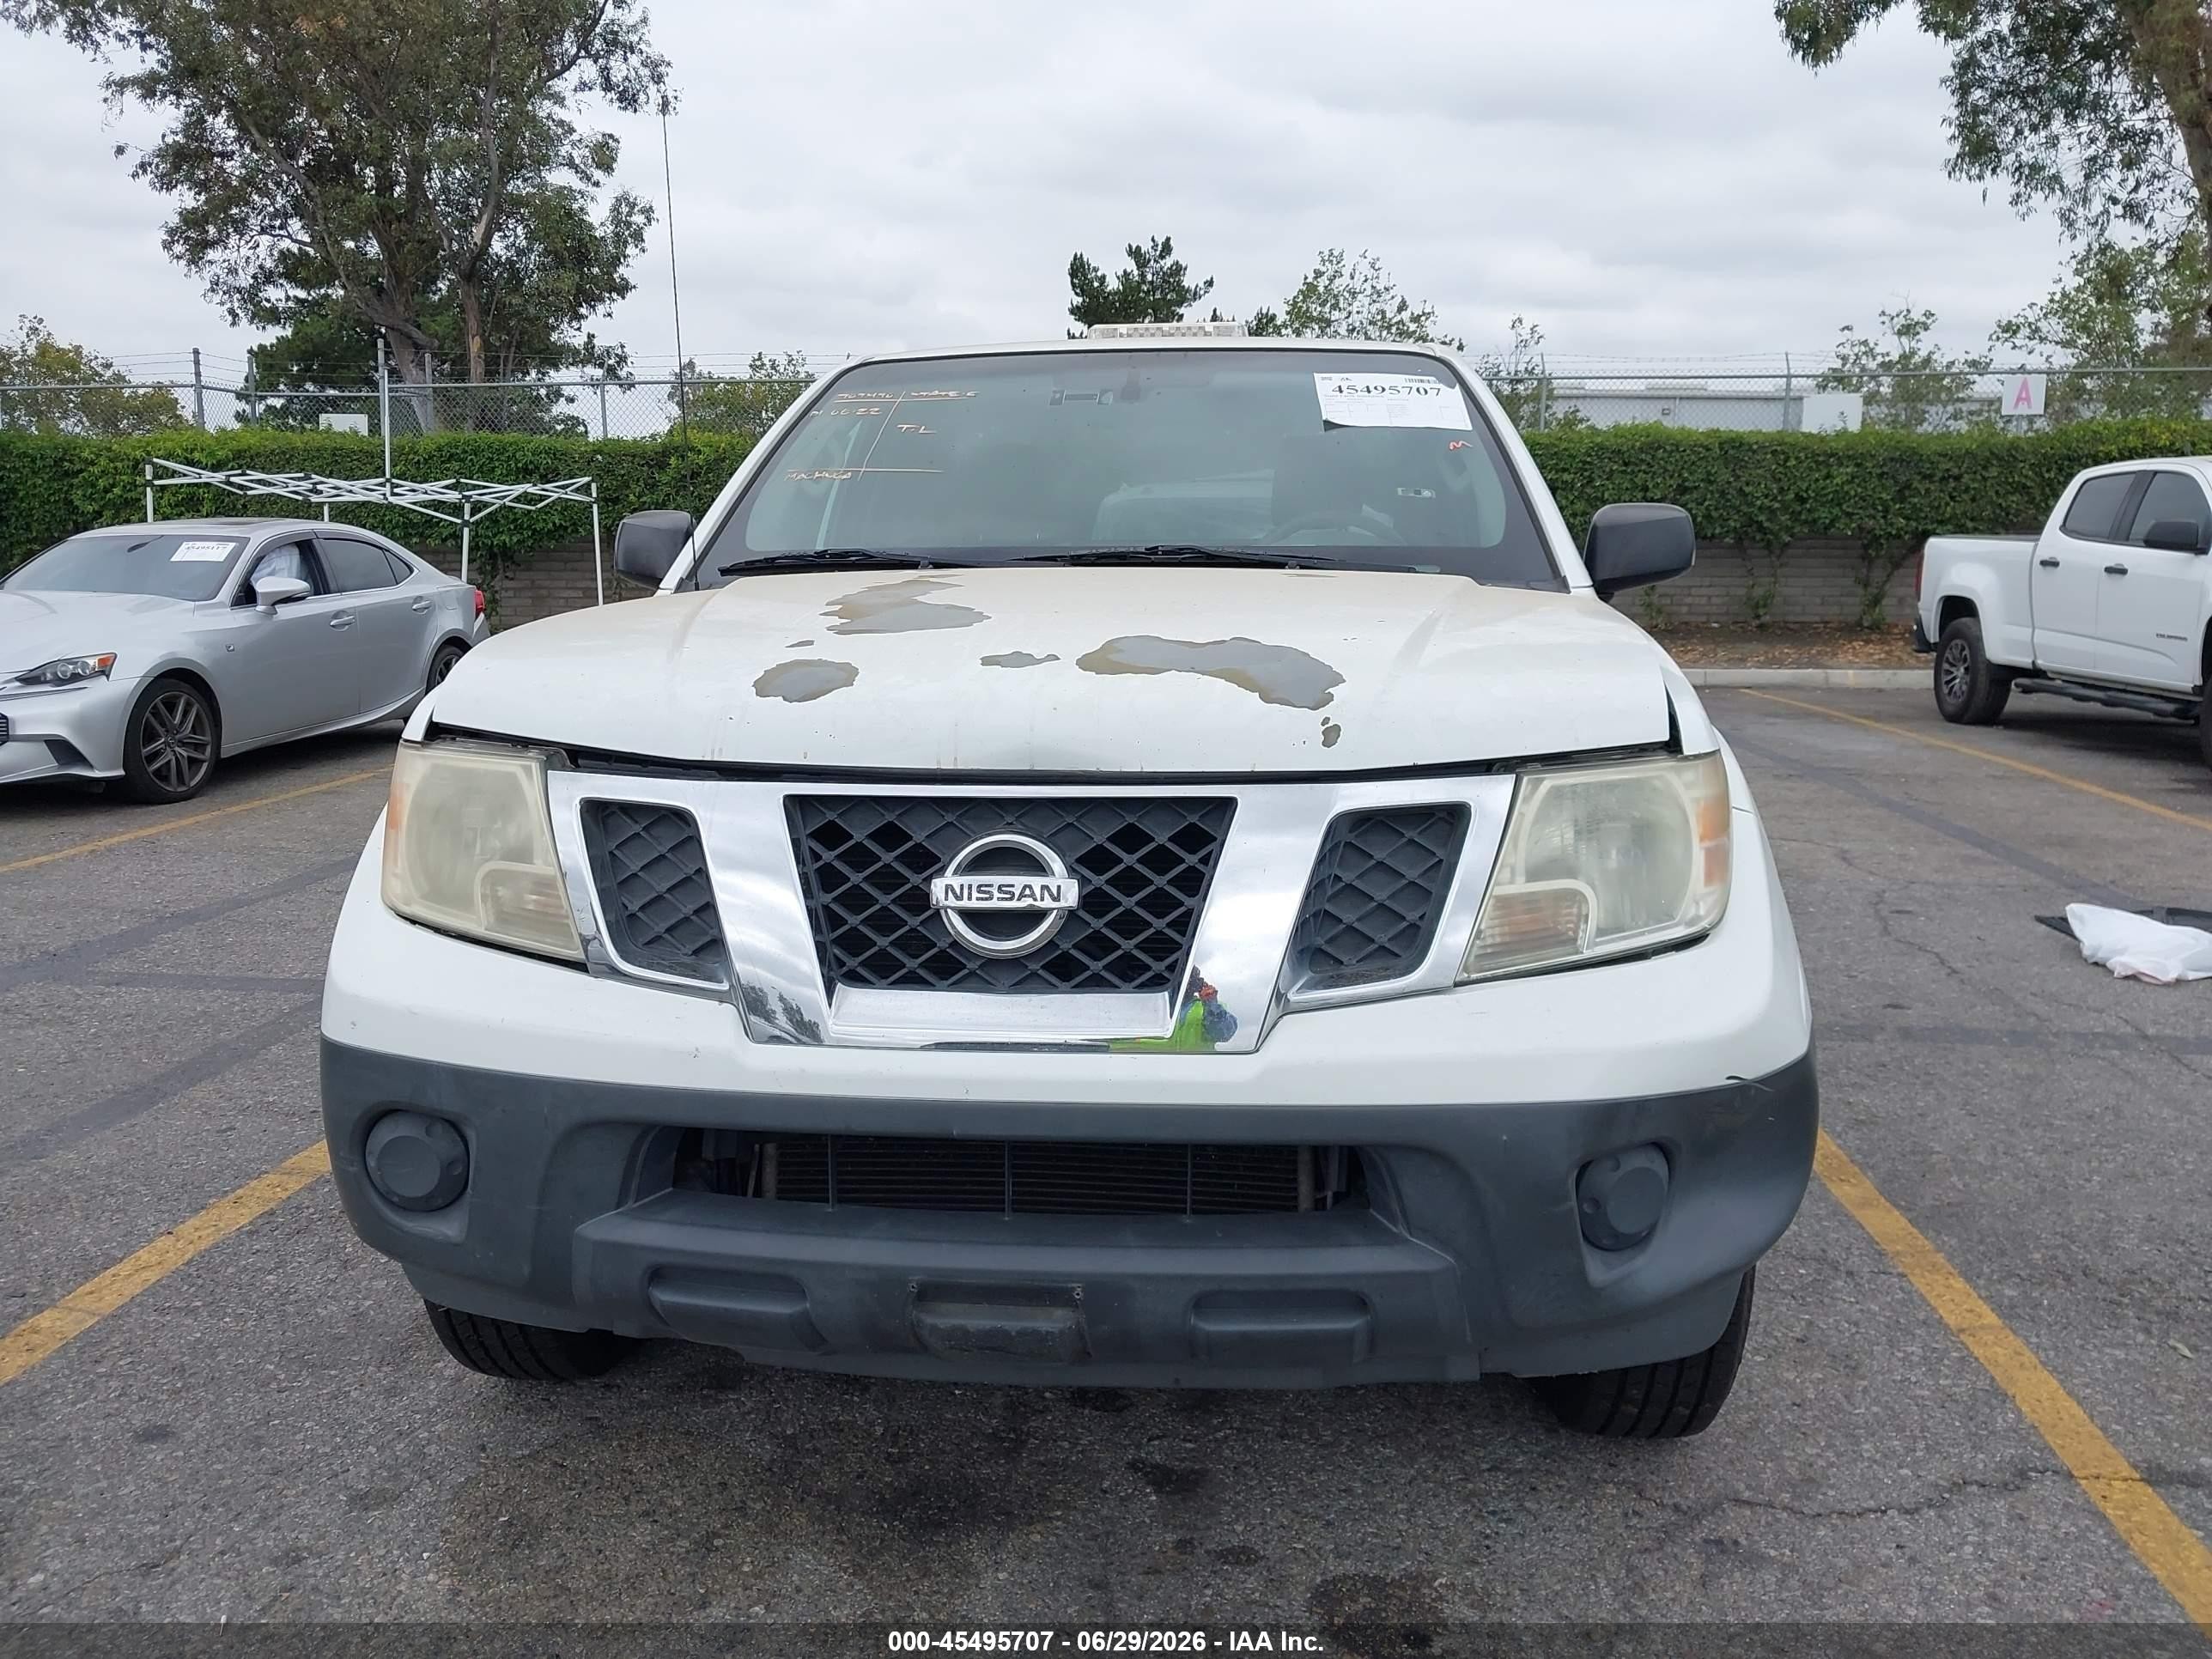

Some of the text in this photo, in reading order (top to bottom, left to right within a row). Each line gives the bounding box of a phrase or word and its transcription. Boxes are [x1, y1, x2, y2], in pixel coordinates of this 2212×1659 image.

[1332, 385, 1442, 397] 45495707
[2013, 377, 2033, 410] A
[945, 884, 1061, 902] NISSAN
